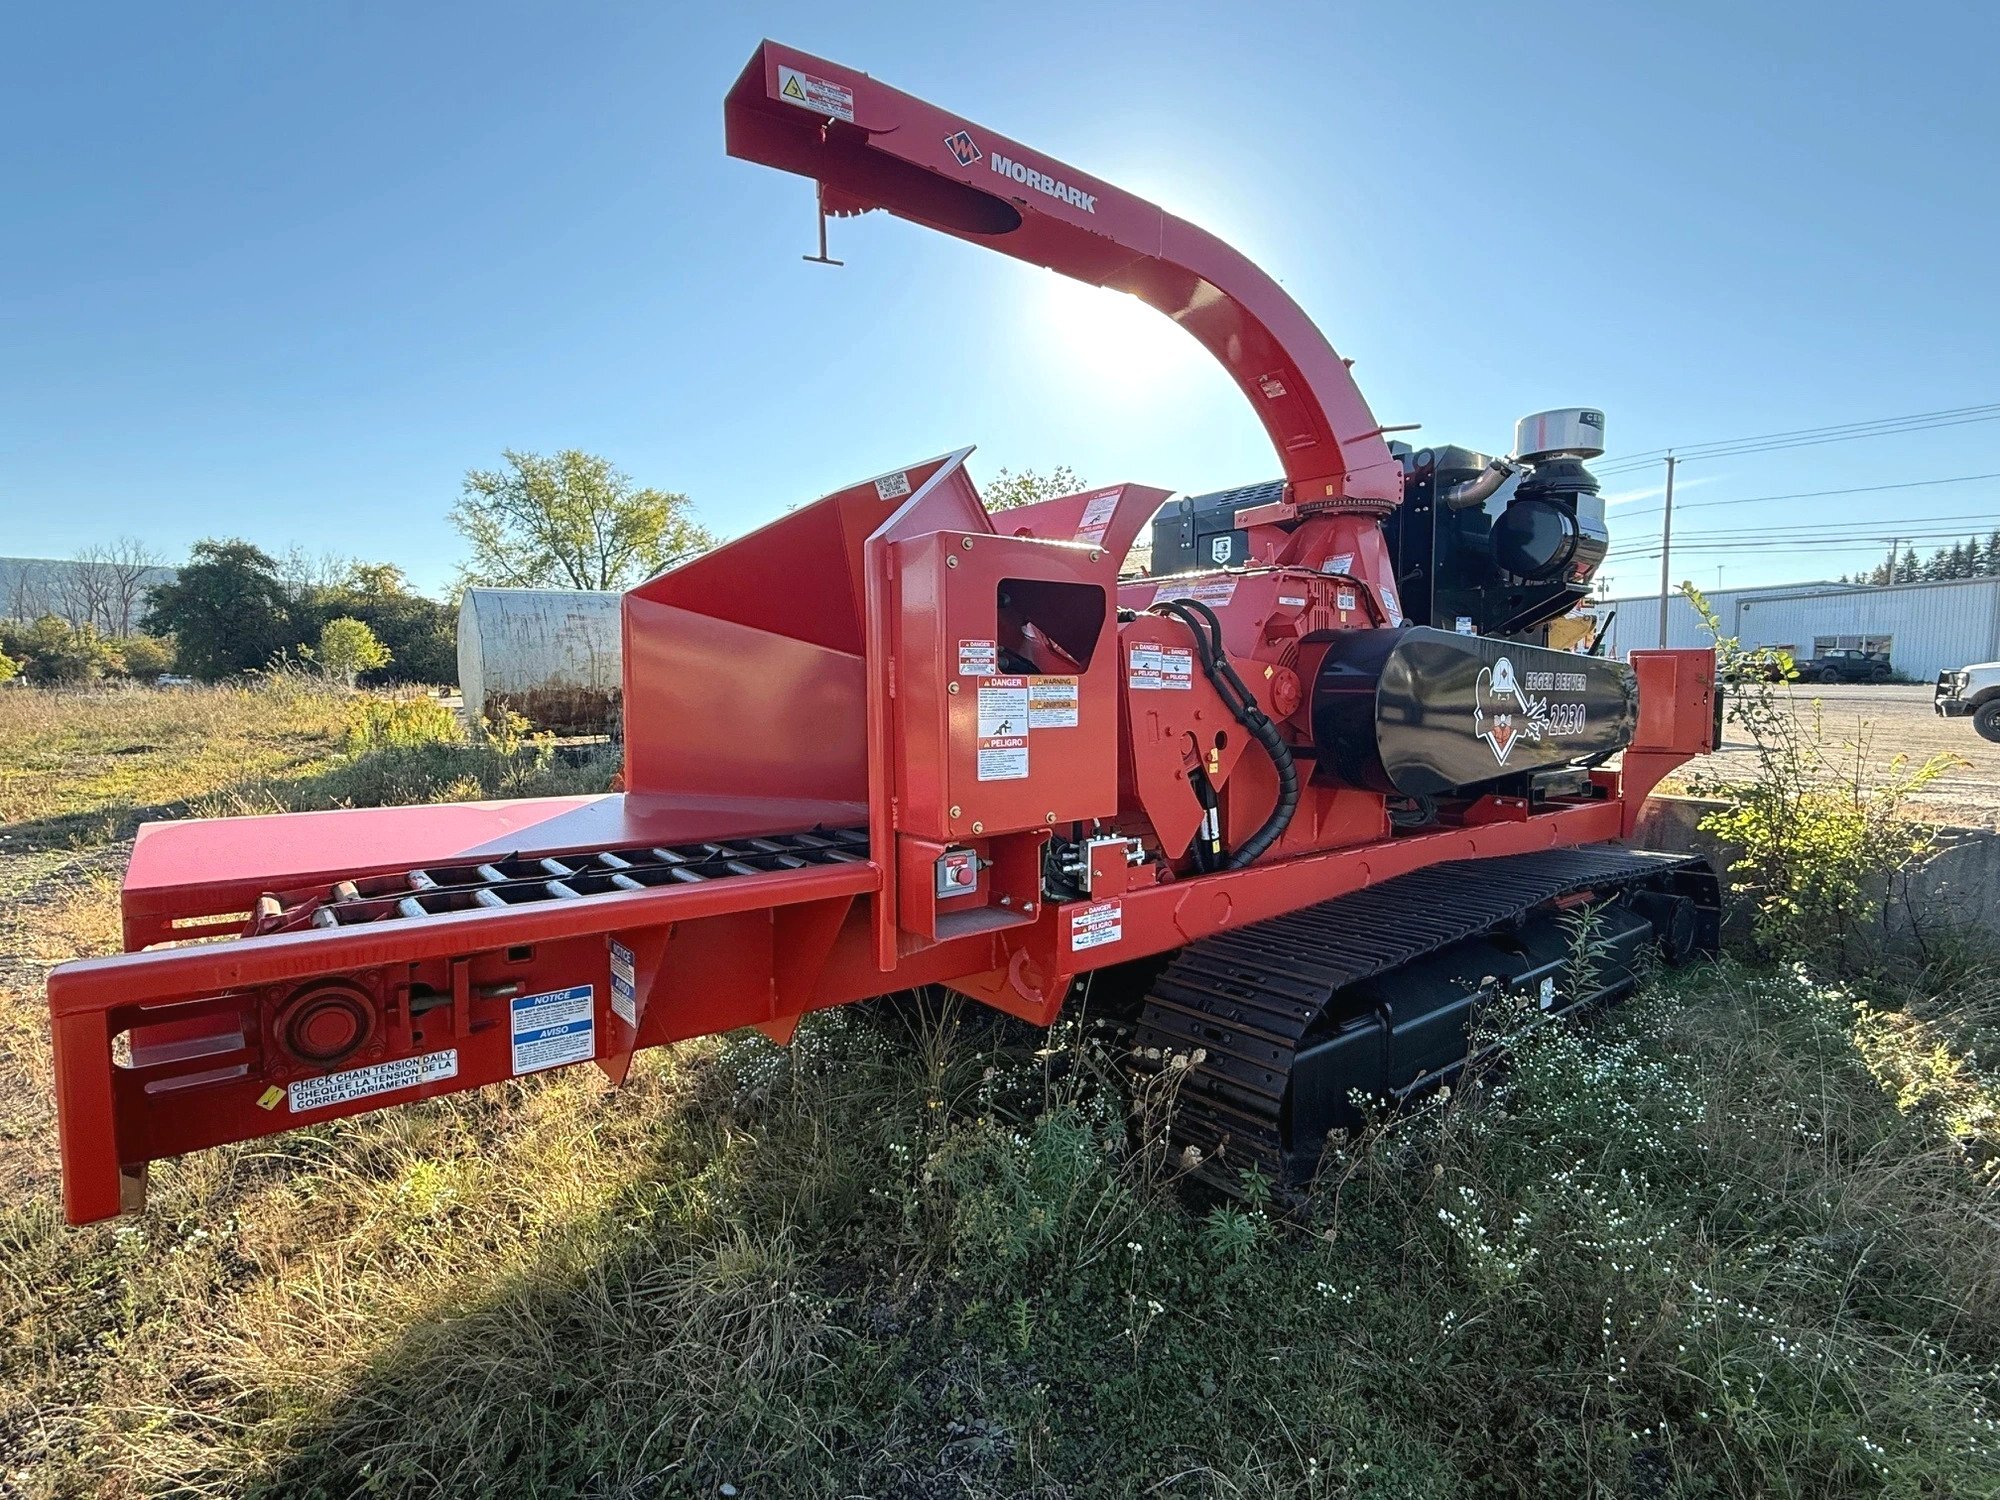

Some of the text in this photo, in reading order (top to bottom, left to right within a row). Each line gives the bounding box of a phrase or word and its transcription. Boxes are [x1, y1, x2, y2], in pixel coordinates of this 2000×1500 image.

[991, 152, 1095, 214] MORBARK
[991, 678, 1022, 687] DANGER
[1043, 678, 1072, 686] WARNING
[1548, 703, 1586, 736] 2230
[990, 738, 1023, 748] PELIGRO
[1088, 903, 1112, 914] DANGER
[1087, 920, 1113, 932] PELIGRO
[612, 942, 632, 963] NOTICE
[615, 977, 631, 996] AVISO
[534, 991, 572, 1006] NOTICE
[540, 1025, 569, 1039] AVISO
[292, 1051, 452, 1093] CHECK CHAIN TENSION DAILY
[296, 1060, 452, 1101] CHEQUEE LA TENSION DE LA
[296, 1074, 422, 1109] CORREA DIARIAMENTE
